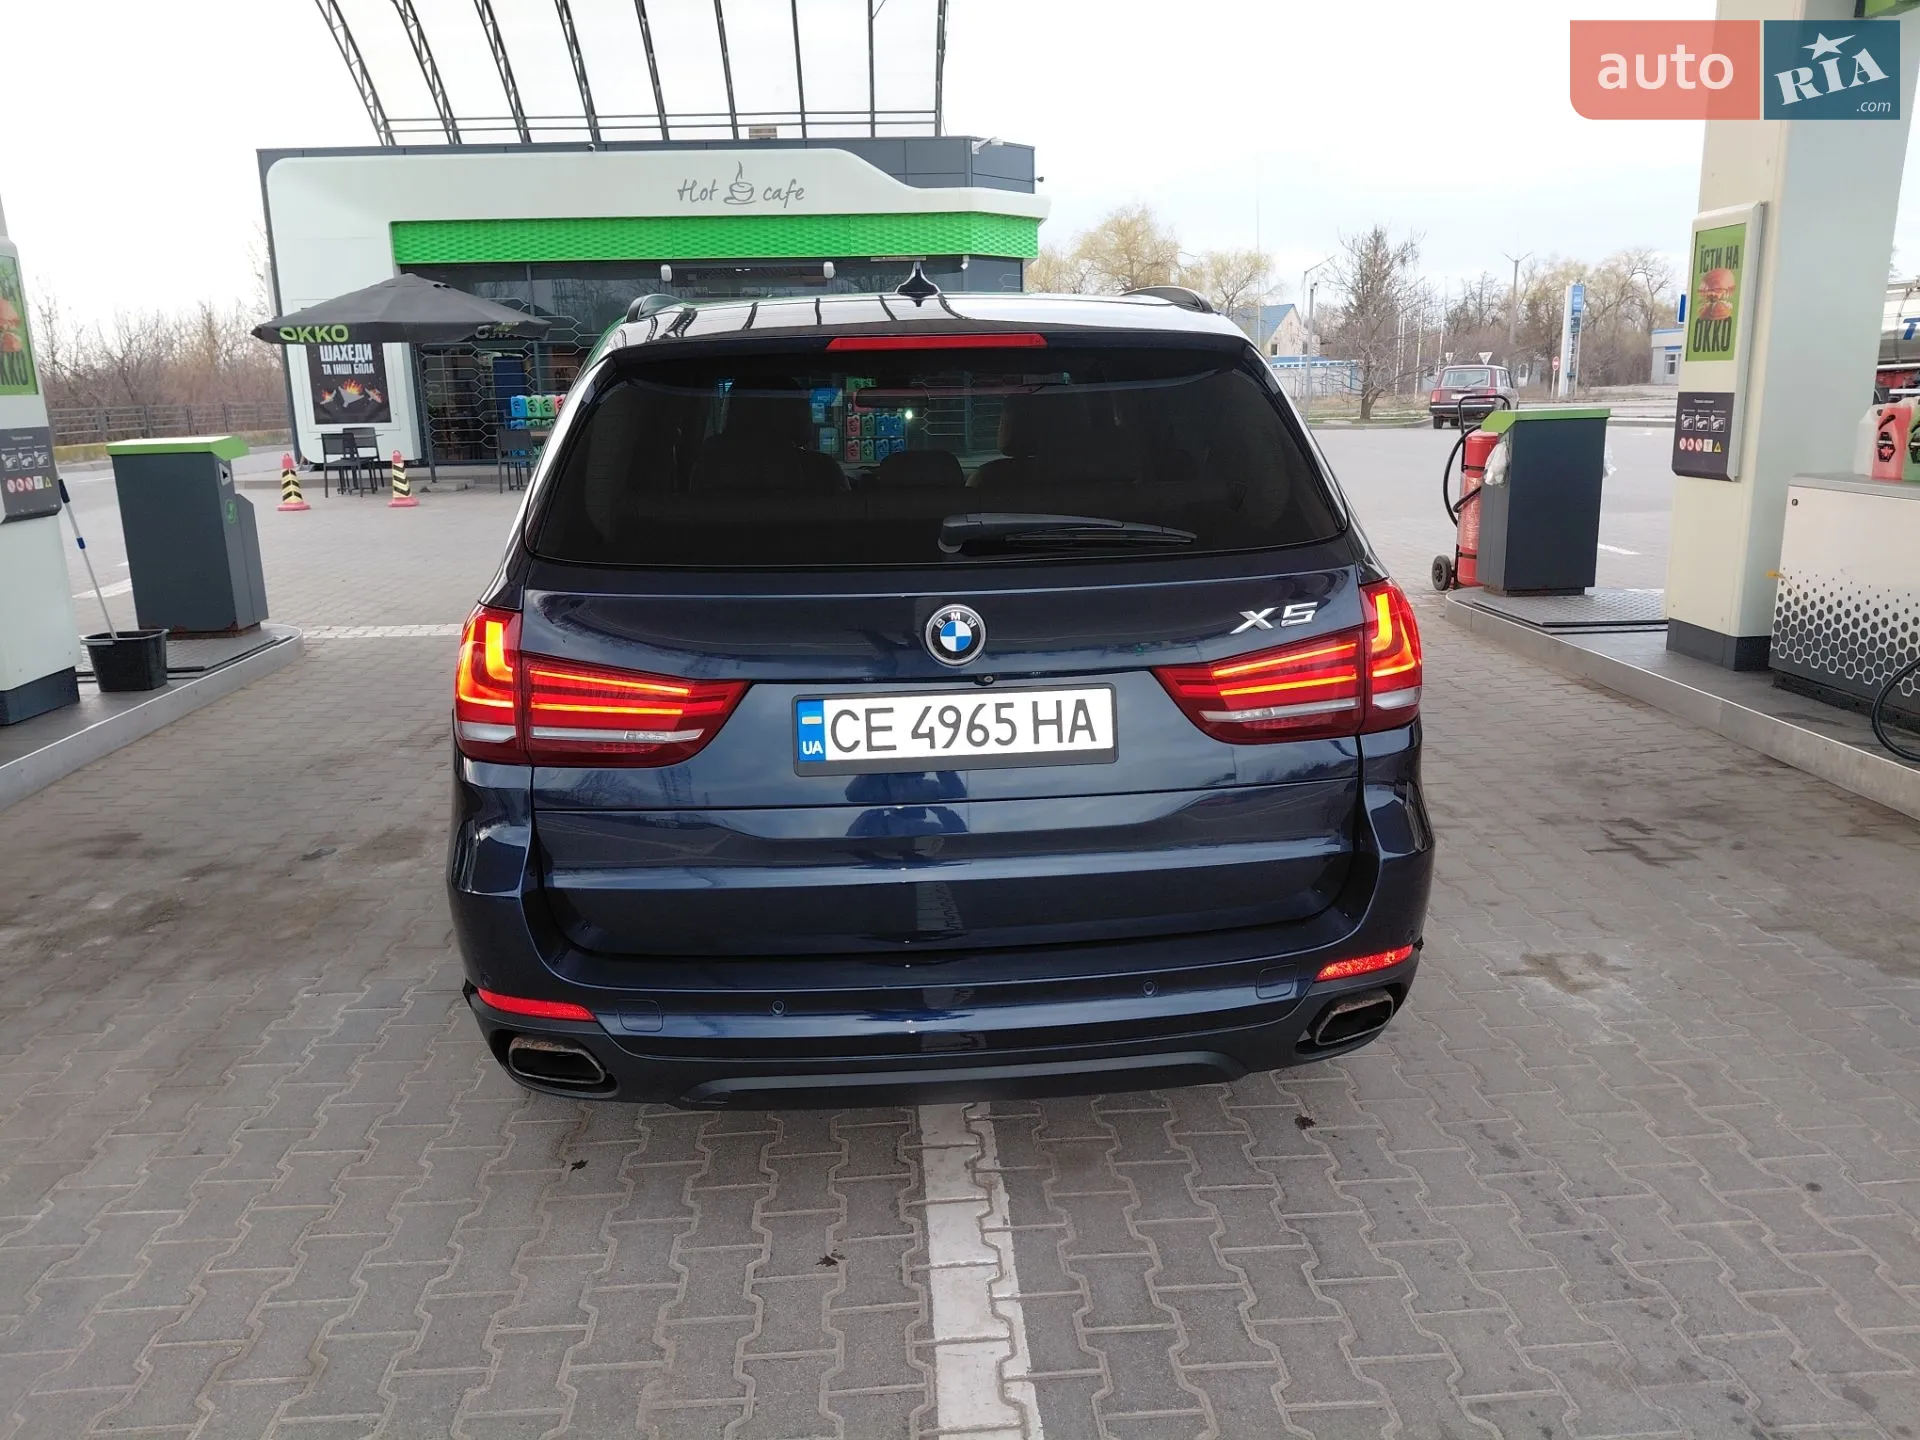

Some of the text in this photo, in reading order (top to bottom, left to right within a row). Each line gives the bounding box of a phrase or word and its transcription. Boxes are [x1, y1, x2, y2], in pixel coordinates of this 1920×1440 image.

[677, 178, 805, 209] Hot cafe
[280, 324, 349, 343] OKKO
[319, 343, 374, 364] ШАХЕДИ
[321, 363, 333, 376] ТА
[353, 362, 375, 375] БПЛА
[935, 611, 977, 630] BMW
[1230, 601, 1319, 635] X5
[830, 698, 1098, 753] CE 4965 HA
[802, 740, 824, 755] UA
